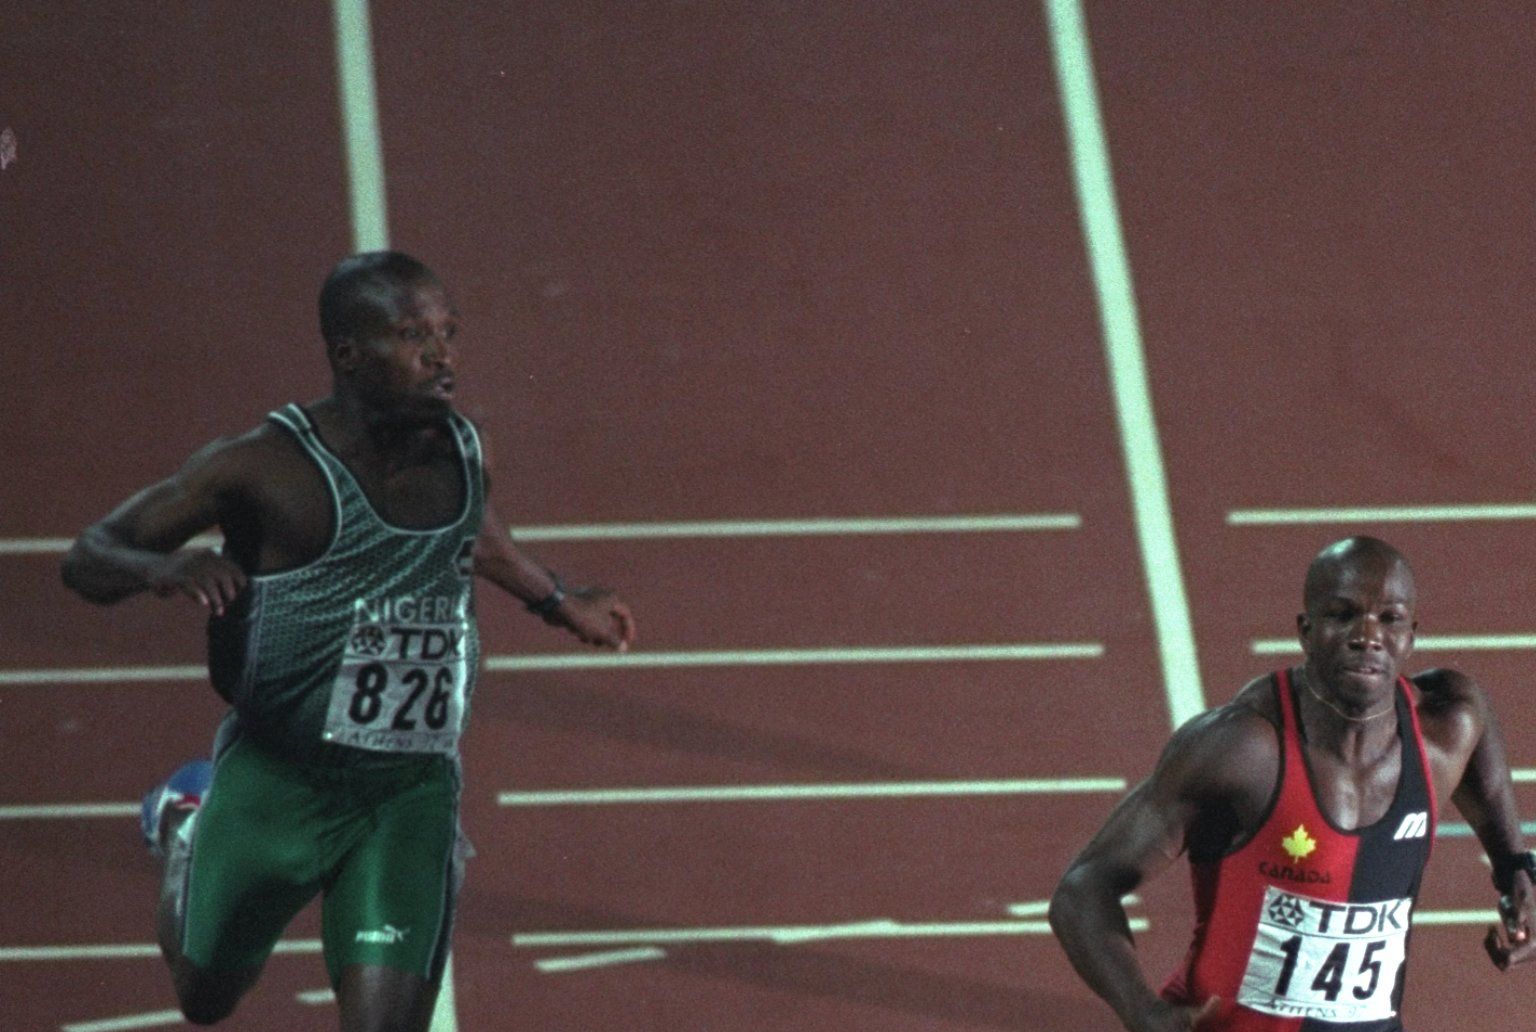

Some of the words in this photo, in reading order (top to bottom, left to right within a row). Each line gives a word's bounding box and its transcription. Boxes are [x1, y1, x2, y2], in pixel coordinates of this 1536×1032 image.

[347, 662, 453, 731] 826
[1258, 860, 1332, 884] CANADA
[1308, 900, 1401, 935] TDK
[1274, 934, 1387, 1002] 145
